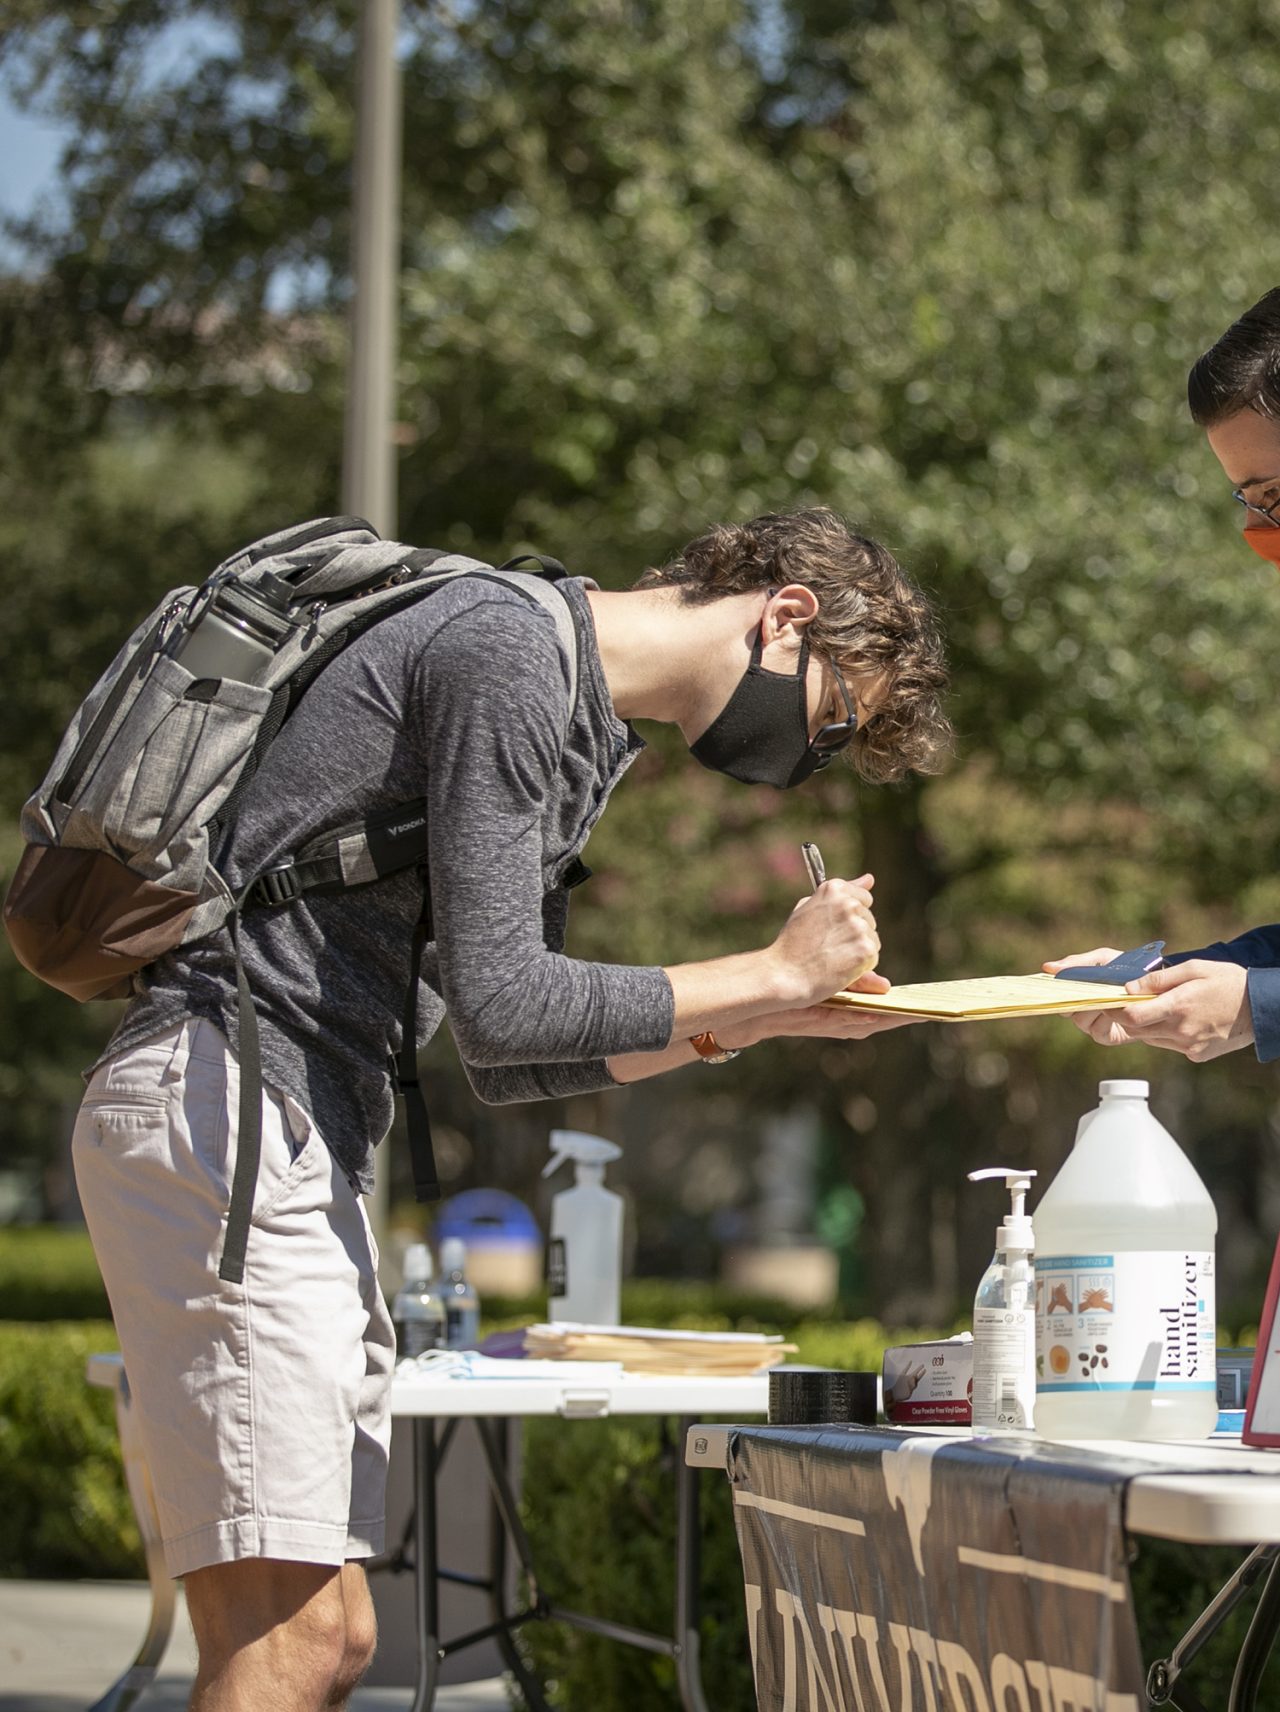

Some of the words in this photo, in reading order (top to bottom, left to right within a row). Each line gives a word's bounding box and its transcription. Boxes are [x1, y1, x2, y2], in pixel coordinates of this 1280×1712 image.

[1159, 1307, 1181, 1377] hand
[1181, 1255, 1198, 1378] sanitizer
[921, 1407, 935, 1415] Powder
[944, 1406, 954, 1415] Vinyl
[744, 1580, 1140, 1712] UNIVER
